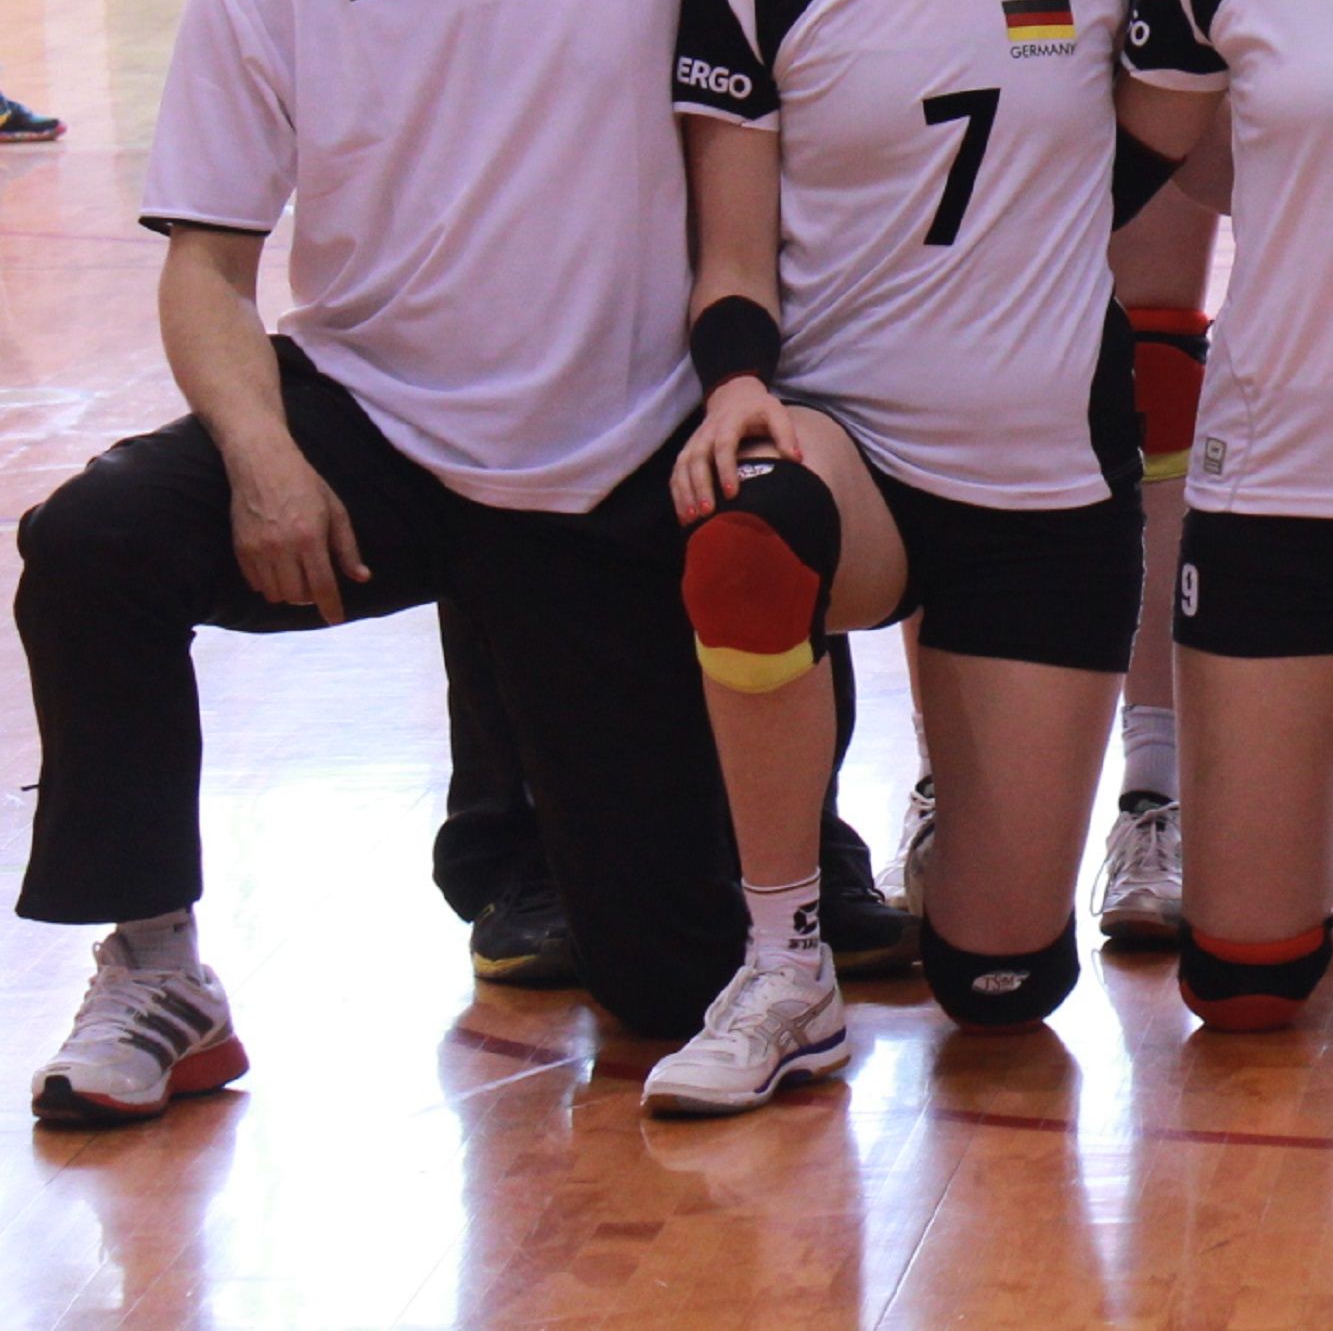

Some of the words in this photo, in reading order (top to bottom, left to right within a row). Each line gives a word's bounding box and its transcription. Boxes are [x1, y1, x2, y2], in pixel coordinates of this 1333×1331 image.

[676, 56, 752, 100] ERGO
[922, 87, 1001, 246] 7
[1181, 562, 1199, 617] 9
